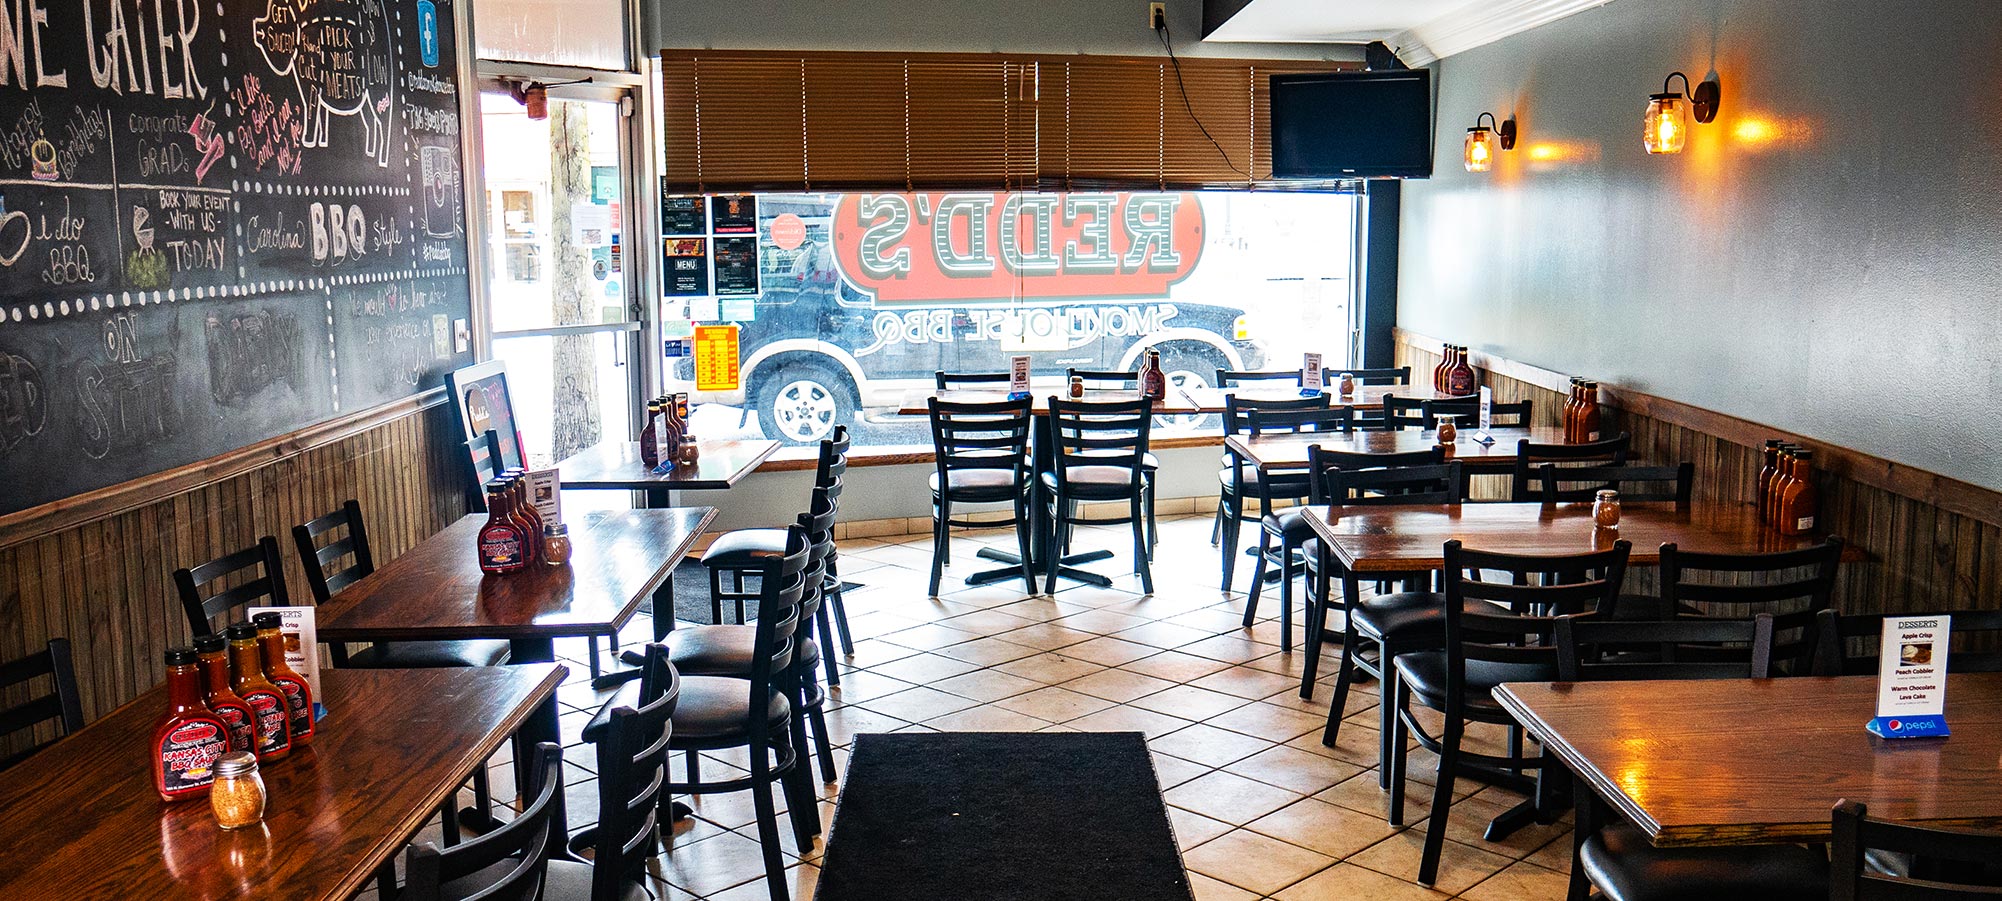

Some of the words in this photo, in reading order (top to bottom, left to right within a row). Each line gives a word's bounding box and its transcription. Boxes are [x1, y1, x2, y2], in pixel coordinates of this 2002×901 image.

[271, 4, 288, 24] GET
[325, 25, 353, 49] PICK
[330, 50, 356, 71] YOUR
[325, 70, 361, 100] MEATS
[159, 190, 180, 209] BOOK
[182, 192, 202, 210] YOUR
[203, 195, 231, 212] EVENT
[247, 211, 305, 253] Carolina
[309, 201, 367, 267] BBQ
[42, 244, 95, 285] BBQ
[166, 236, 226, 273] TODAY
[676, 260, 697, 270] MENU
[1898, 620, 1938, 629] DESSERTS
[1905, 720, 1937, 731] pepsi
[162, 747, 204, 762] KANSAS
[204, 740, 227, 755] CITY
[171, 759, 192, 772] BBQ
